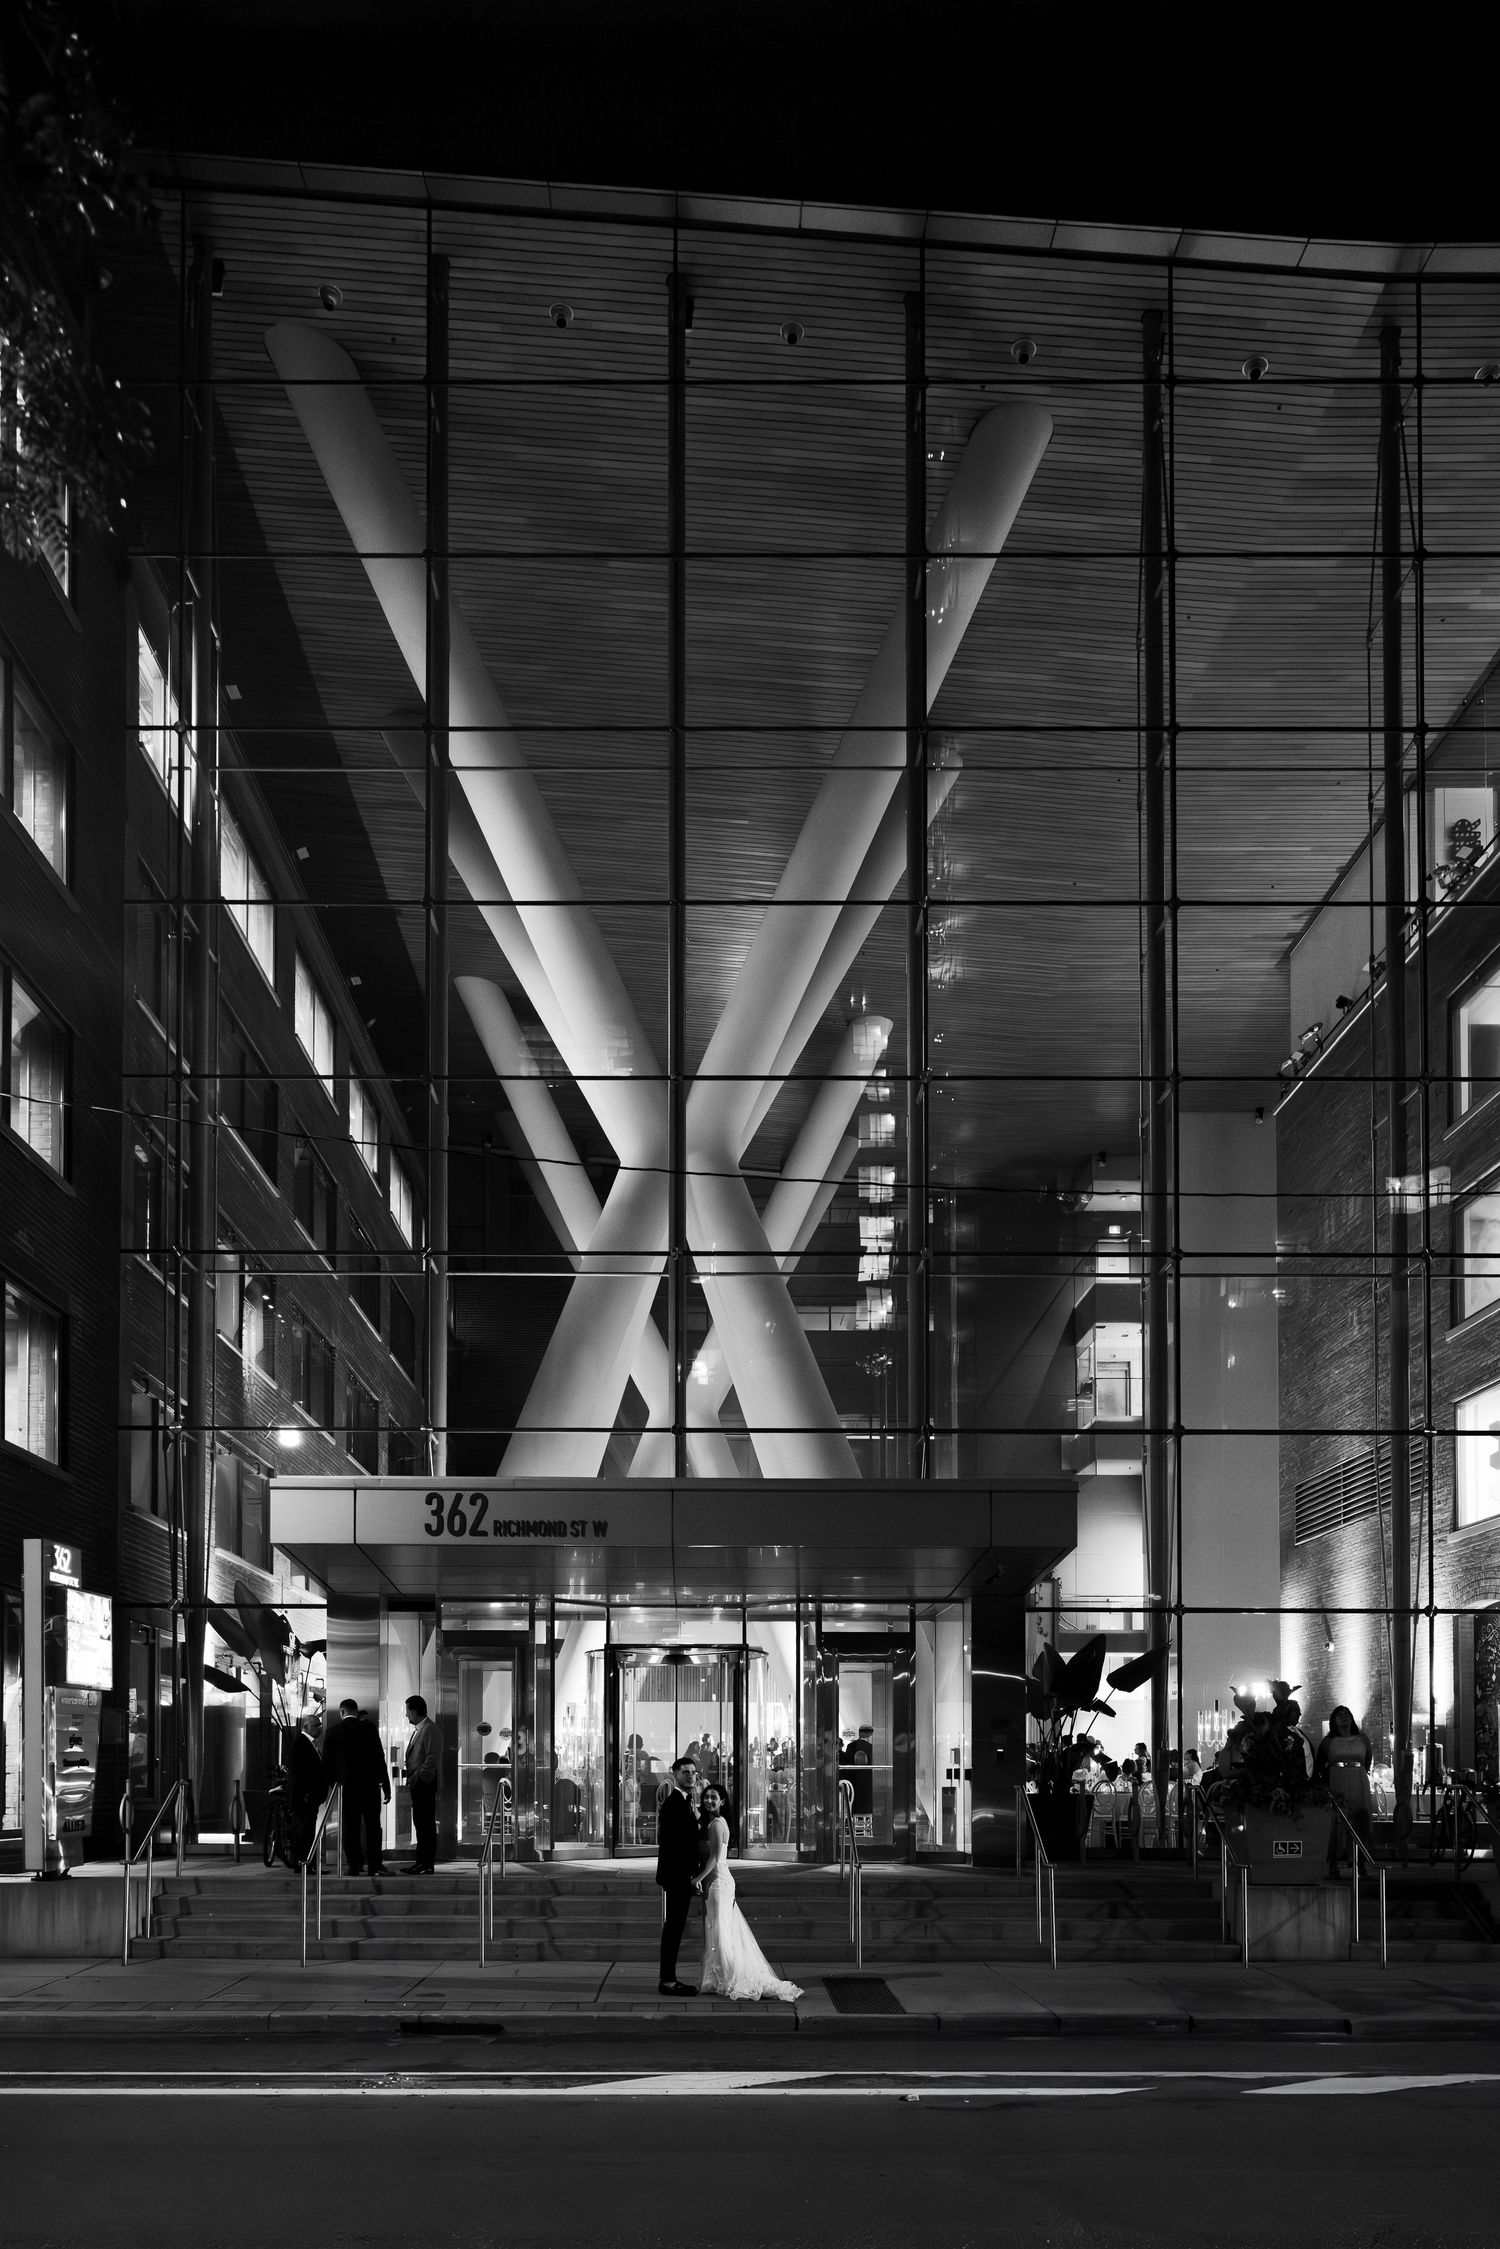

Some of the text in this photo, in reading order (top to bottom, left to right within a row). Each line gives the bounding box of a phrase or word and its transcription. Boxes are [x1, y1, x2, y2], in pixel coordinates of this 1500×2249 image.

[424, 1492, 609, 1538] 362 RICHMOND ST W
[53, 1544, 72, 1574] 362
